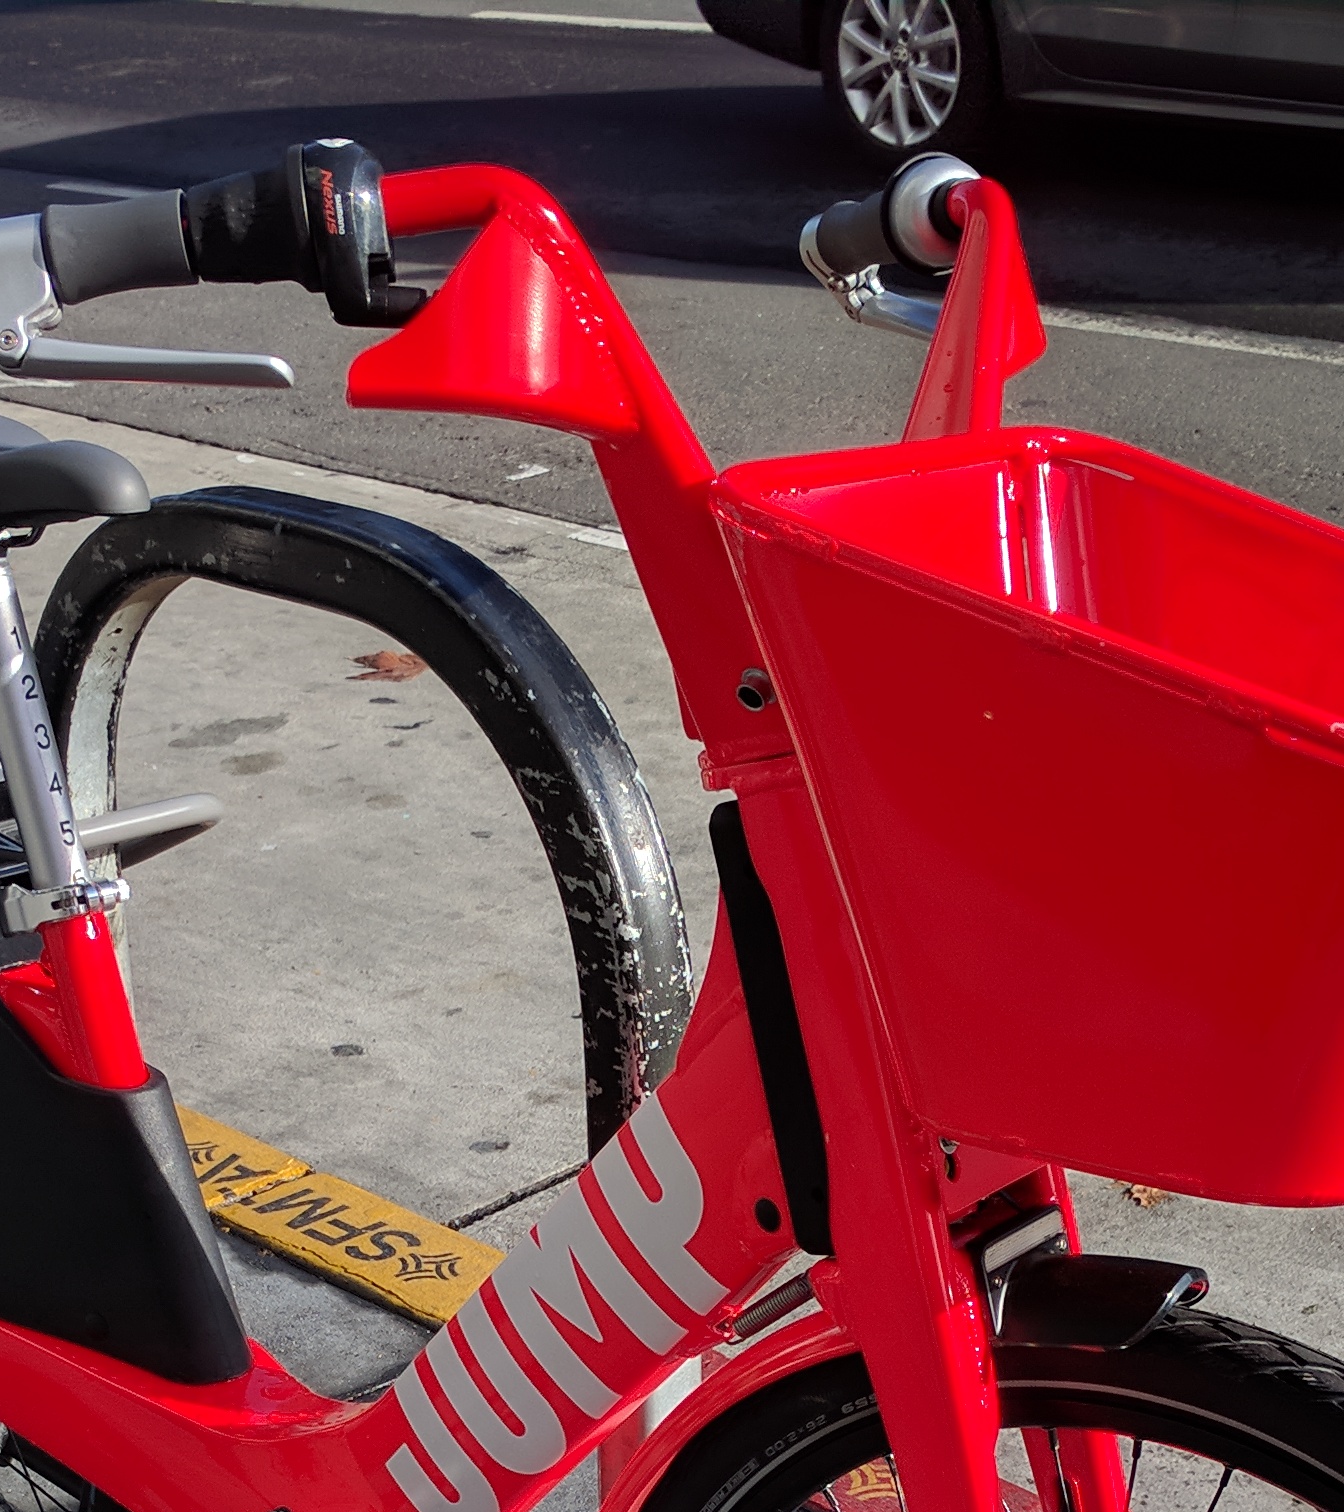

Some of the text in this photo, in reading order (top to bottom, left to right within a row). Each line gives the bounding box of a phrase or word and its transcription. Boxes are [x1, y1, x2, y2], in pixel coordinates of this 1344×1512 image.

[10, 626, 22, 650] 1
[21, 674, 39, 700] 2
[34, 723, 50, 750] 3
[49, 772, 62, 796] 4
[59, 820, 75, 847] 5
[198, 1152, 422, 1262] SFMTA
